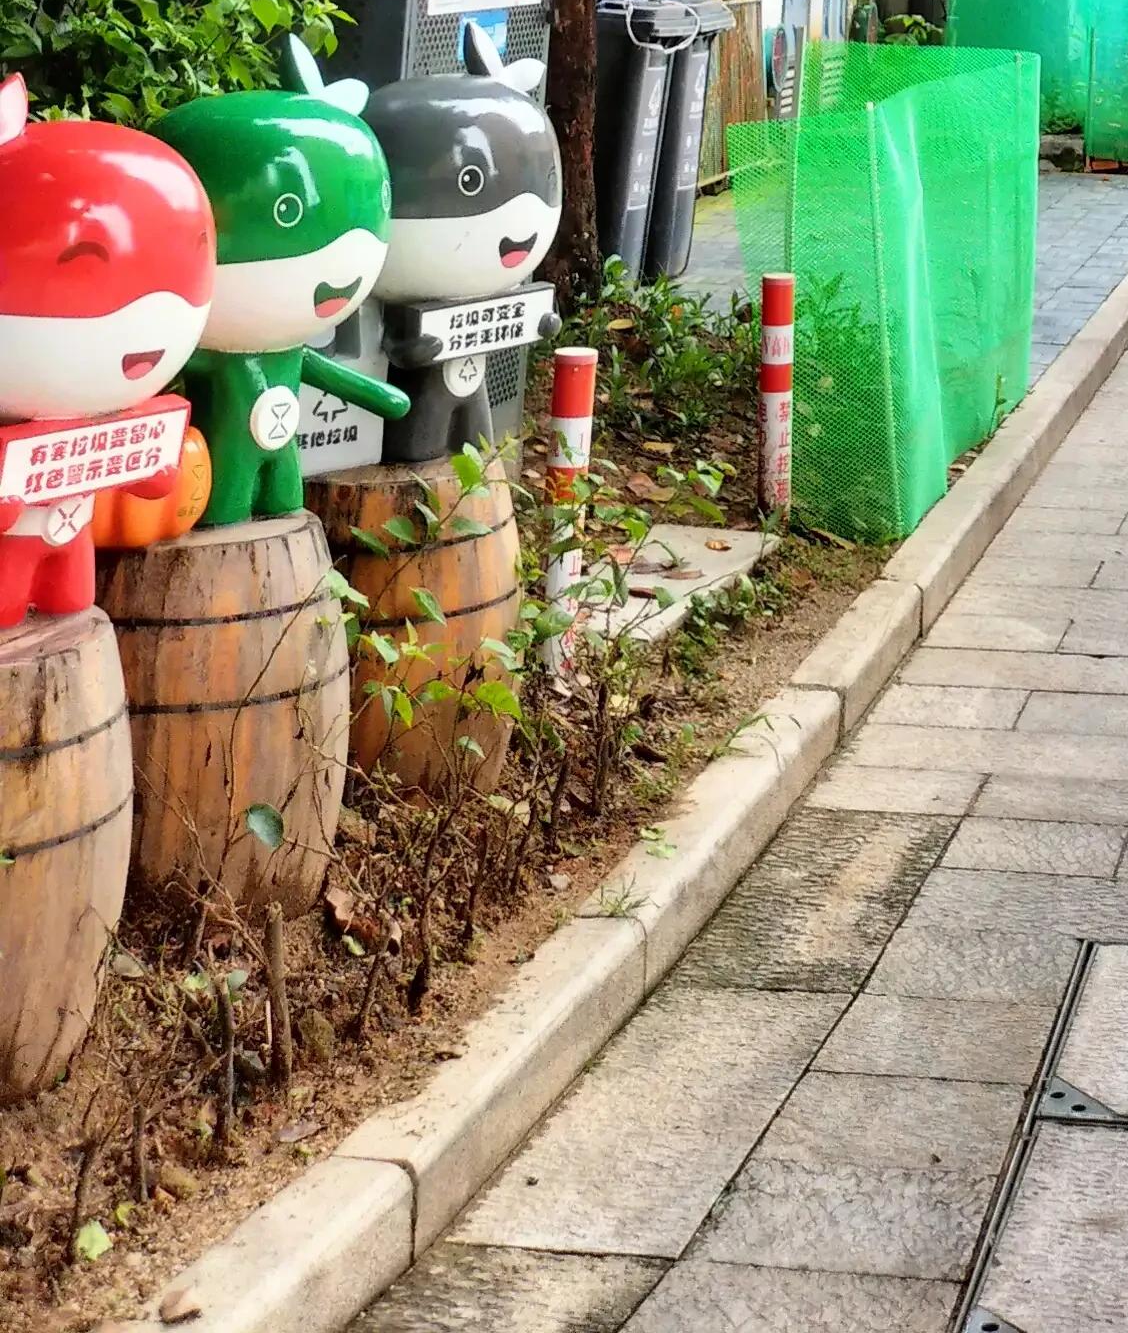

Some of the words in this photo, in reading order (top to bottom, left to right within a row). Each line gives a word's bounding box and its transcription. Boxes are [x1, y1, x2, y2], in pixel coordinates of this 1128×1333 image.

[449, 302, 525, 330] 垃圾可变宝
[449, 322, 524, 351] 分类更环保
[30, 420, 165, 466] 有害垃圾要留心
[24, 447, 162, 495] 红色警示要区分
